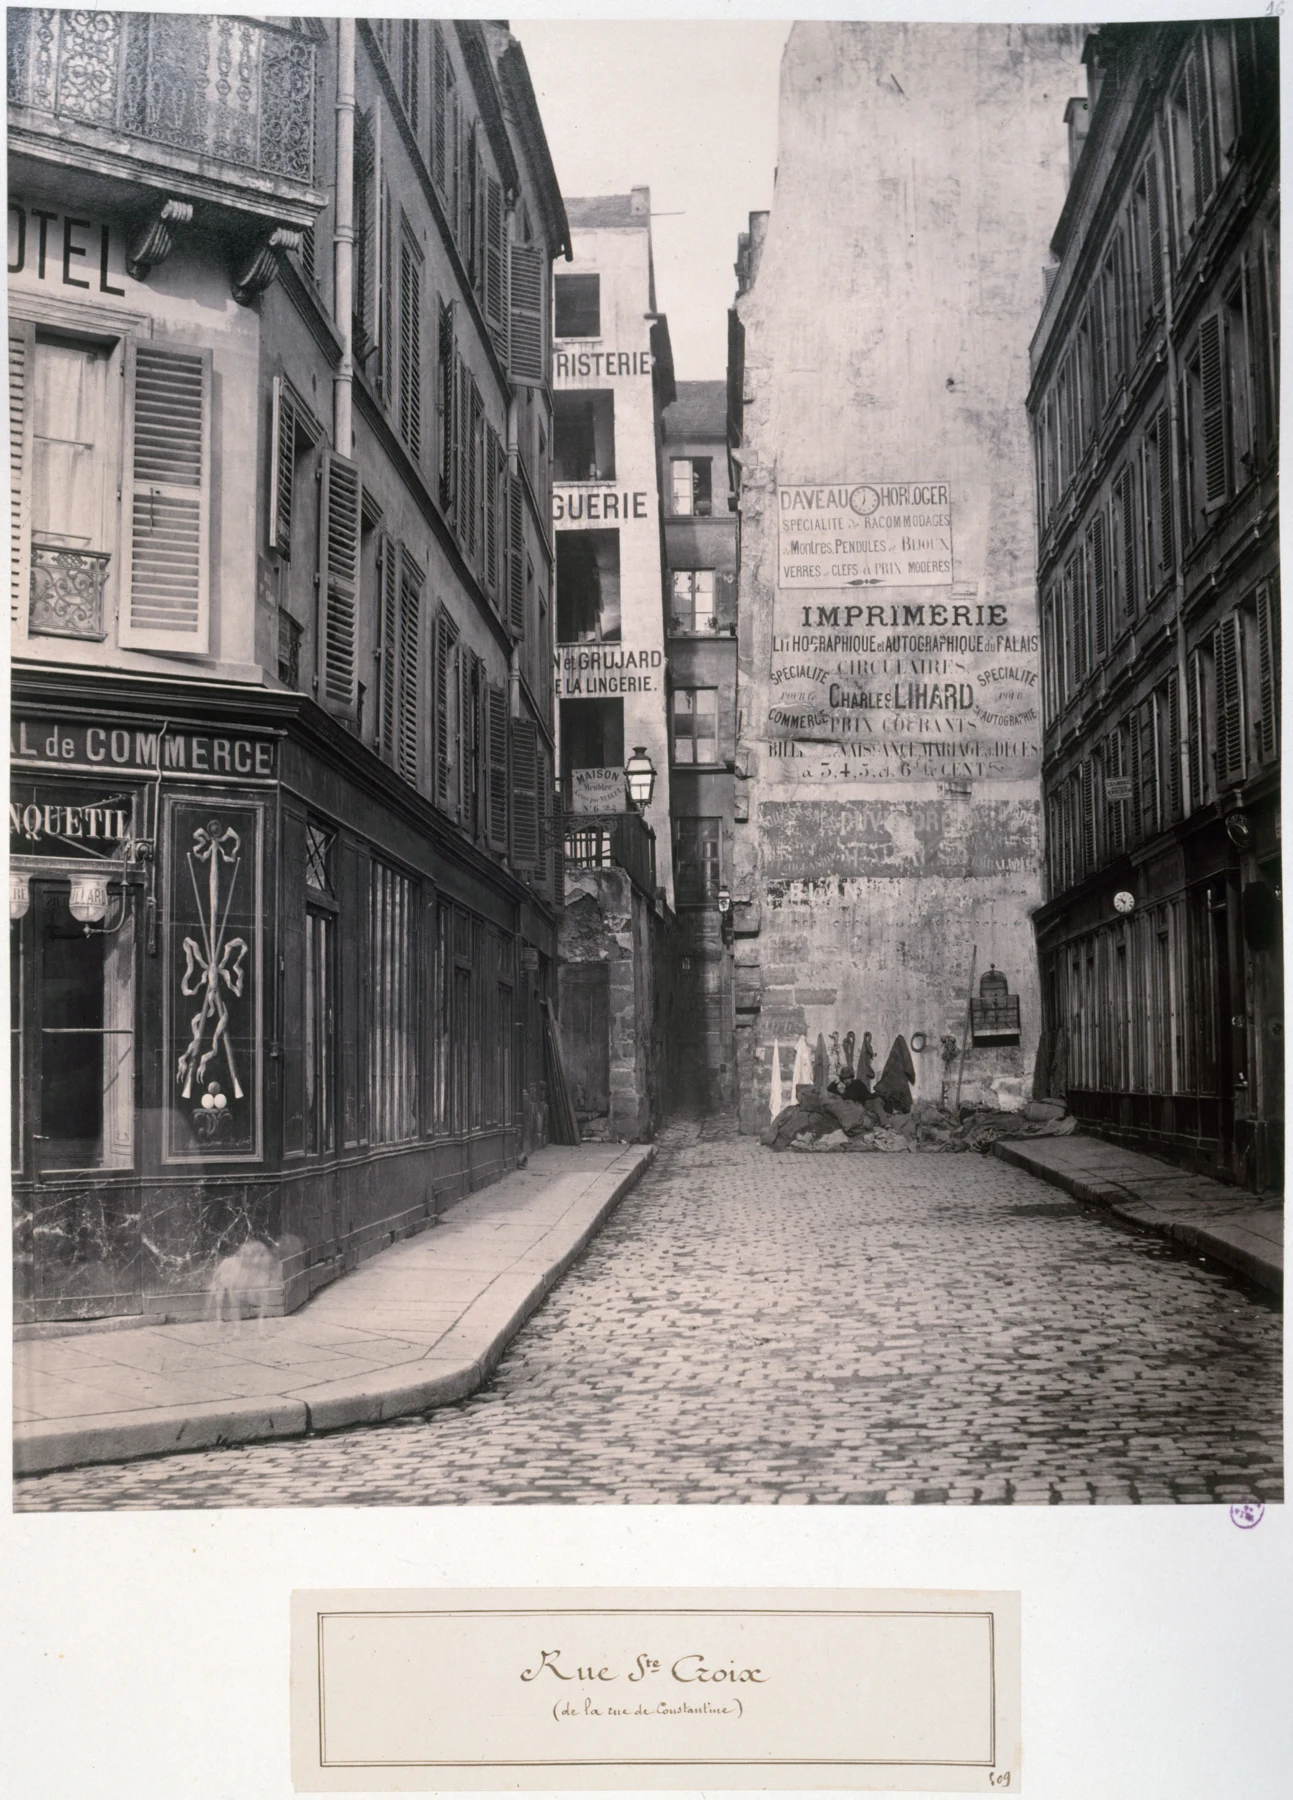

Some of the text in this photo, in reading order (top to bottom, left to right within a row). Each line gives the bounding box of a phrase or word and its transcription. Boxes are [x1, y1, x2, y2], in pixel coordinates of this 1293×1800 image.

[556, 351, 651, 377] RISTERIE
[552, 492, 648, 520] GUERIE
[780, 485, 948, 511] DAVEAU HORLOGER
[864, 514, 950, 529] RACOMMODAGES
[835, 538, 886, 554] PENDULES
[902, 535, 949, 552] BIJOUX
[783, 565, 821, 578] VERRES
[831, 563, 859, 577] CLEFS
[875, 561, 902, 576] PRIX
[802, 604, 1008, 627] IMPRIMERIE
[773, 635, 1038, 655] LITHOGRAPHIQUE et AUTOGRAPHIQUE du PALAIS
[563, 655, 576, 671] et
[578, 650, 662, 670] GRUJARD
[566, 678, 582, 694] LA
[894, 683, 974, 710] LIHARD
[768, 708, 829, 730] COMMERCE
[831, 717, 873, 733] PRIX
[45, 724, 76, 759] de
[85, 727, 272, 775] COMMERCE
[576, 769, 620, 785] MAISON
[520, 1649, 618, 1682] Rue
[671, 1654, 772, 1683] Croix
[584, 1697, 602, 1716] la
[607, 1706, 630, 1716] rue
[634, 1702, 656, 1716] de
